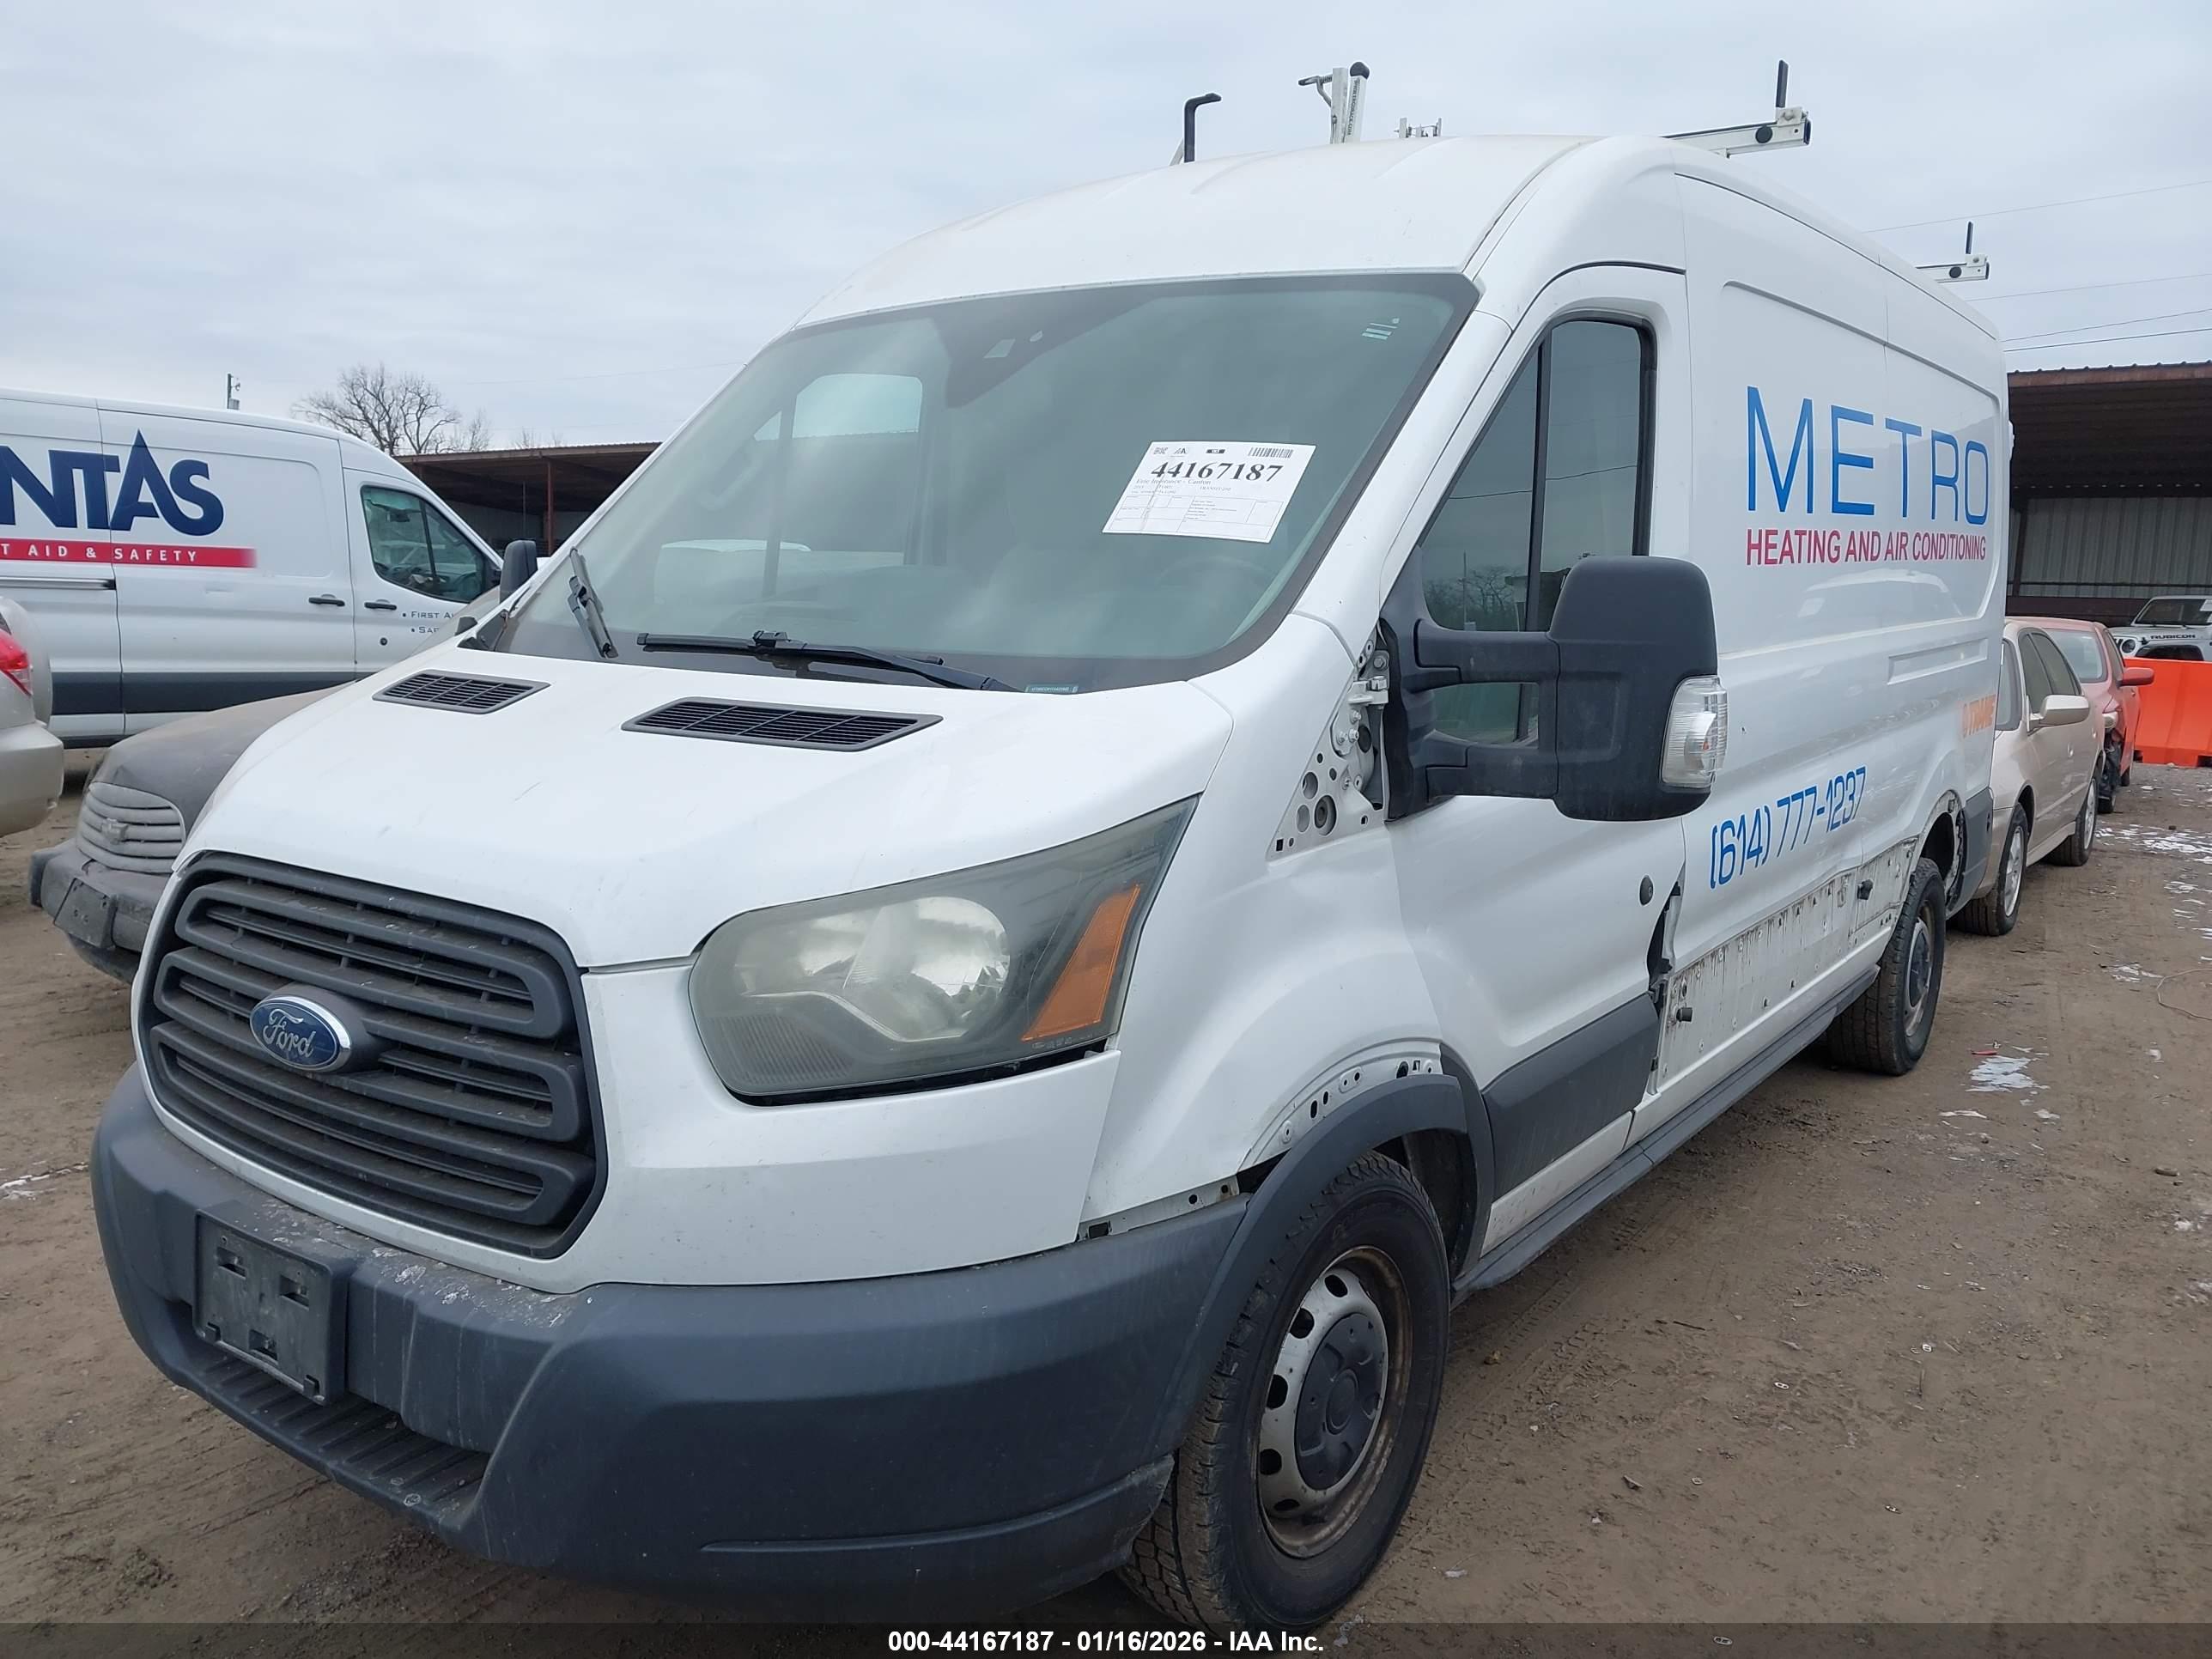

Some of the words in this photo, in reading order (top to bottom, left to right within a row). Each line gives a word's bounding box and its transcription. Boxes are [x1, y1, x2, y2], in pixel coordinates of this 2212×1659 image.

[1151, 461, 1285, 483] 44167187
[1747, 386, 1990, 526] METRO
[27, 544, 68, 557] AID
[86, 547, 97, 558] &
[114, 549, 197, 562] SAFETY
[1747, 529, 1841, 566] HEATING
[1844, 531, 1881, 562] AND
[1884, 532, 1909, 562] AIR
[1912, 532, 1986, 561] CONDITIONING
[410, 611, 441, 619] FIRST
[1710, 805, 1771, 890] (614)
[1776, 765, 1867, 858] 777-1237
[263, 1008, 317, 1058] Ford
